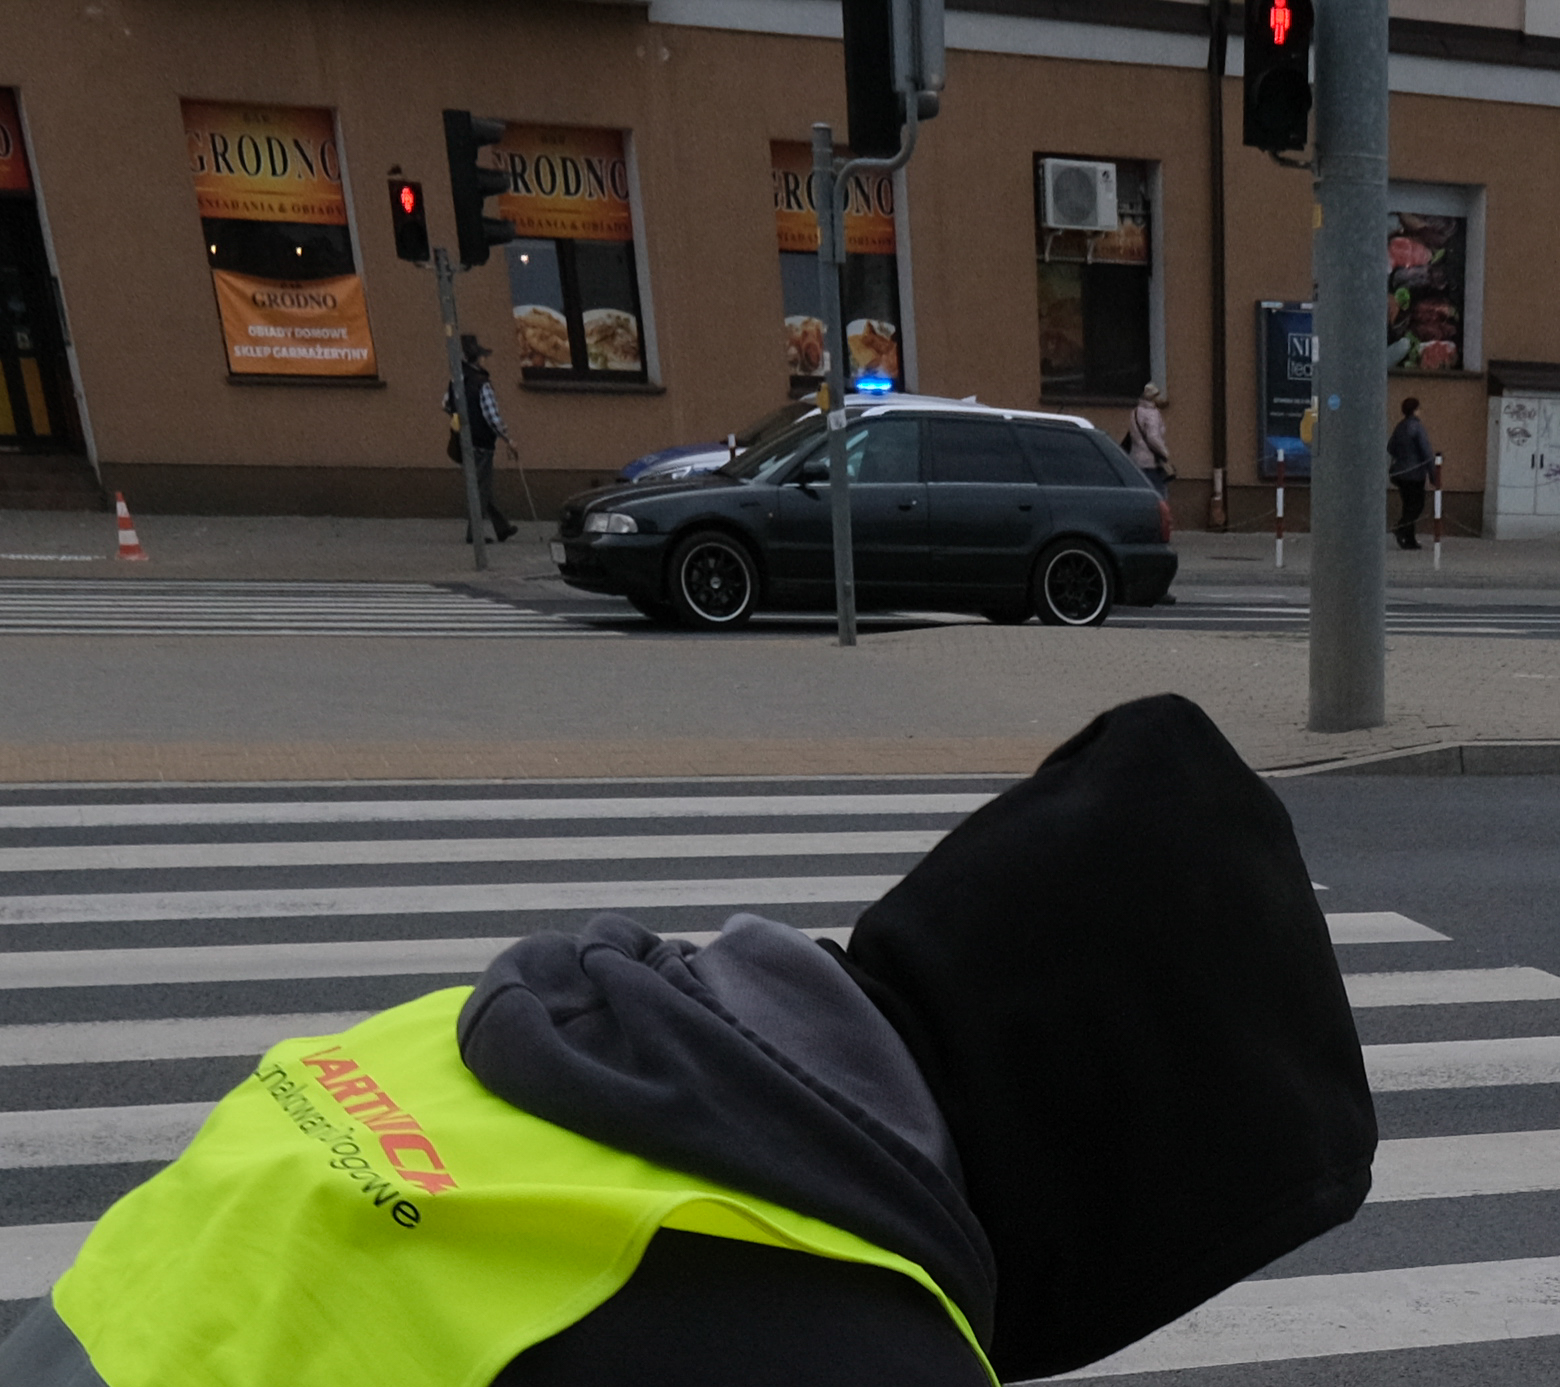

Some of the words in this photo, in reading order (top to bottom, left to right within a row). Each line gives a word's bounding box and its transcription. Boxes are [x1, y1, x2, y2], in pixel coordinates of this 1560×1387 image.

[186, 131, 341, 181] GRODNO
[493, 152, 629, 200] RODNO
[251, 291, 338, 310] GRODNO
[248, 325, 293, 339] OBIADY
[294, 326, 348, 340] DOMOWE
[233, 344, 270, 359] SKLEP
